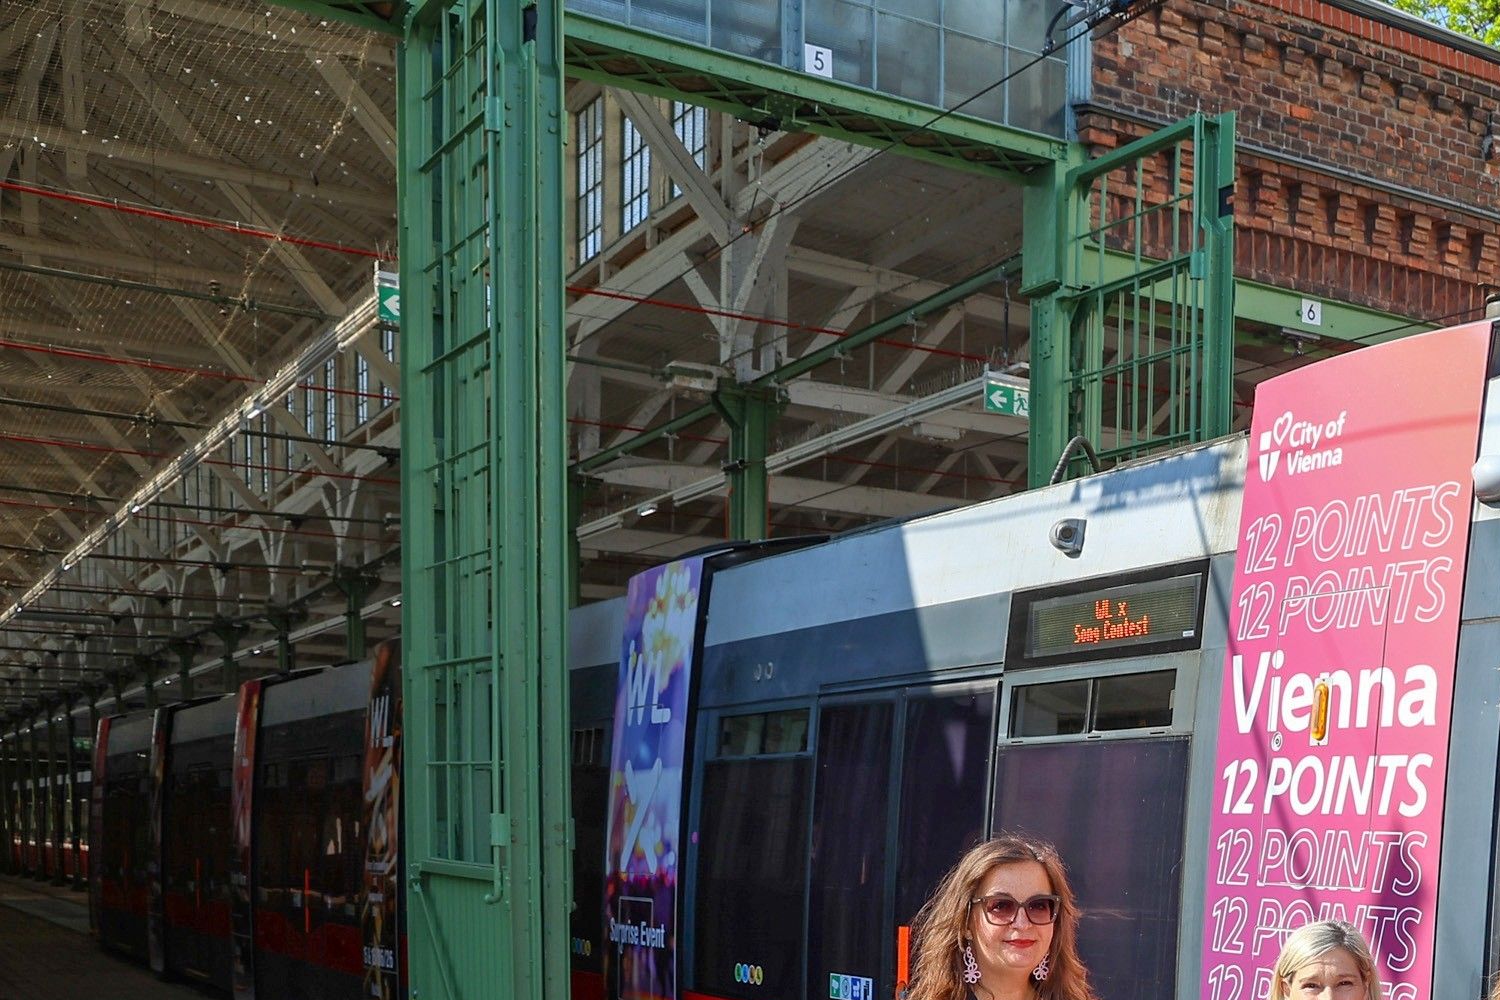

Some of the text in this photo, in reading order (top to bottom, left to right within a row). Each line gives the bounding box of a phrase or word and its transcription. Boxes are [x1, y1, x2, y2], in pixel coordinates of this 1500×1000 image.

[813, 50, 825, 71] 5
[1307, 303, 1316, 321] 6
[1289, 410, 1347, 449] City of
[1287, 448, 1344, 476] Vienna
[1244, 481, 1461, 575] 12 POINTS
[1237, 556, 1453, 642] 12 POINTS
[1074, 615, 1149, 644] Song Contest
[1232, 650, 1438, 734] Vienna
[1222, 753, 1434, 818] 12 POINTS
[1216, 828, 1428, 896] 12 POINTS
[609, 916, 666, 954] Surprise Event
[1212, 896, 1248, 954] 12
